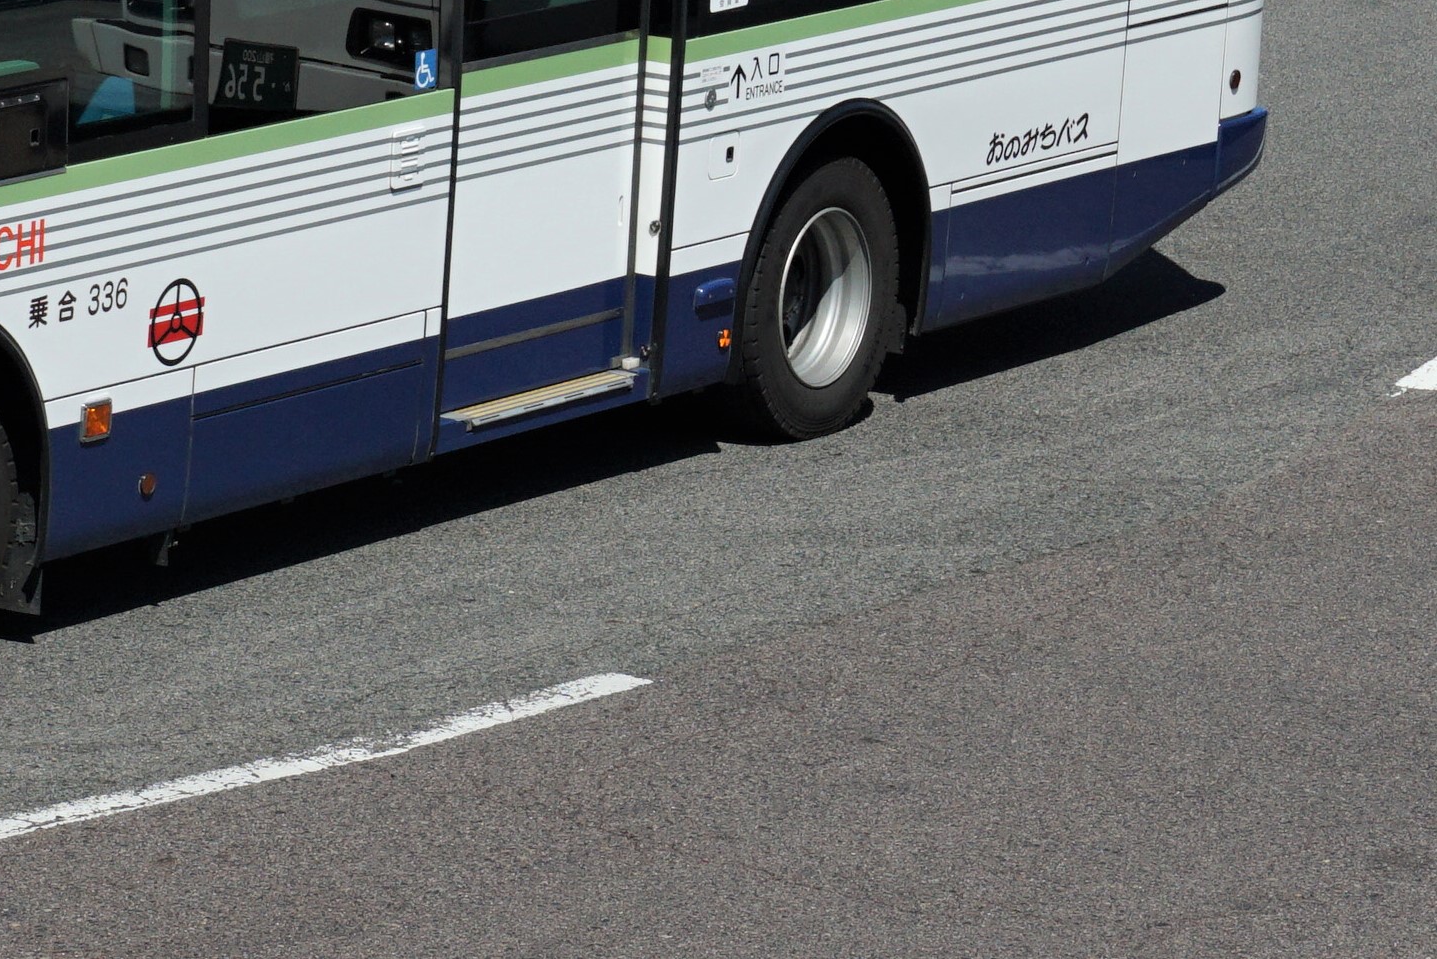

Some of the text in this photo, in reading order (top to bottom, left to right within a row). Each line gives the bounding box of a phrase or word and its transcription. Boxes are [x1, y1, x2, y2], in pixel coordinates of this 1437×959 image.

[751, 53, 780, 81] 入口
[745, 80, 783, 100] ENTRANCE
[986, 112, 1090, 166] おのみちバス
[28, 278, 129, 329] 乗合 336
